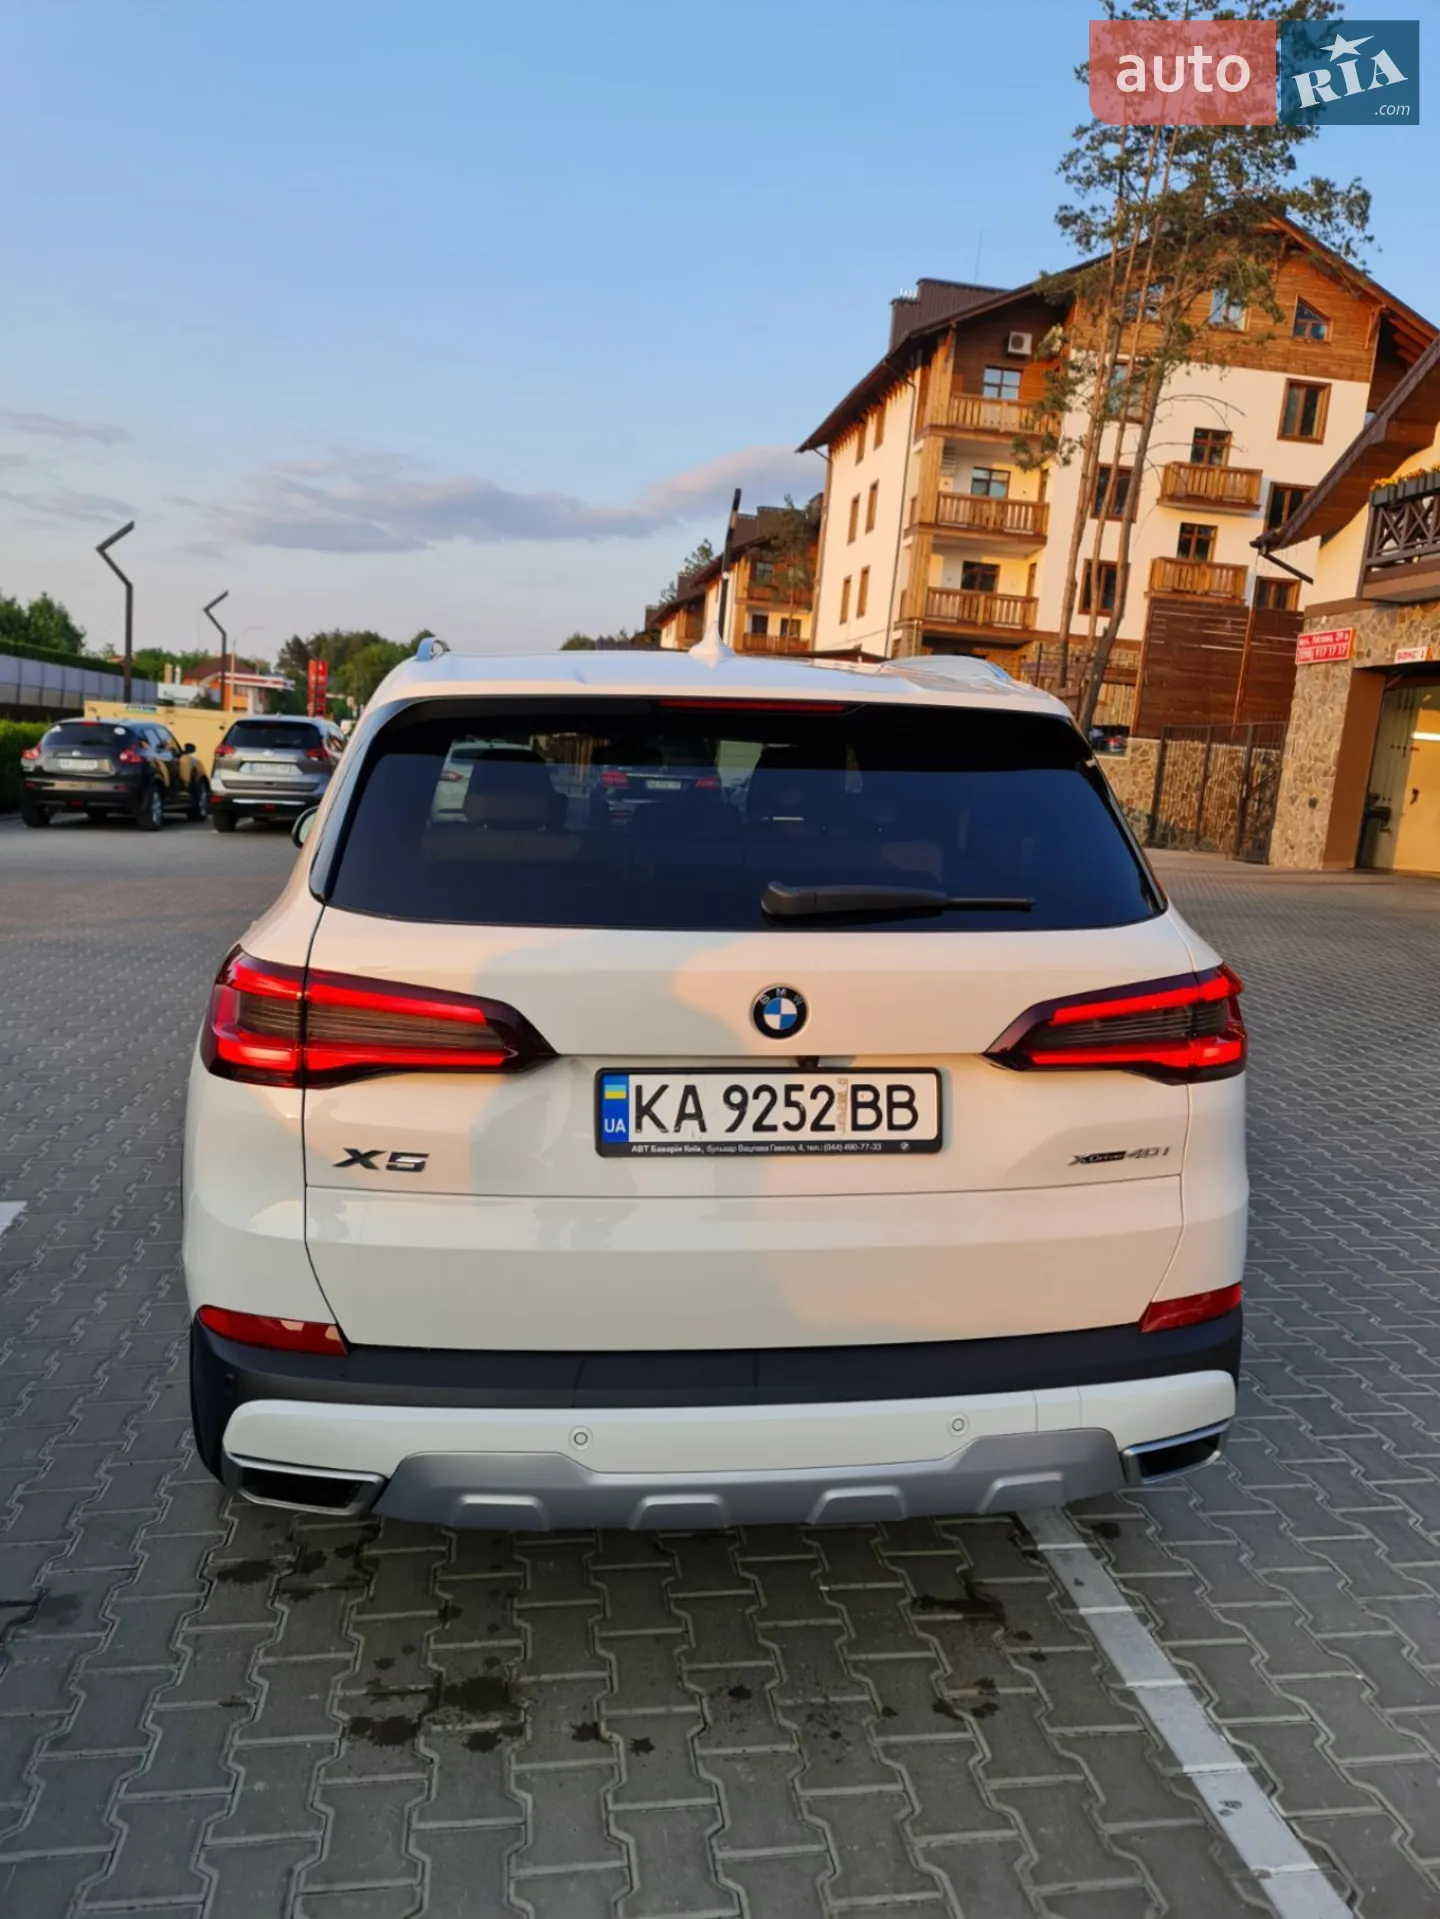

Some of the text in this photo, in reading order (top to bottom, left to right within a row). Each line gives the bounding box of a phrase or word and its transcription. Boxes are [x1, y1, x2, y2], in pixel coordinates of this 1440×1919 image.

[759, 988, 804, 1006] BMW
[634, 1084, 919, 1134] KA 9252 BB
[604, 1118, 626, 1133] UA
[332, 1147, 430, 1172] X5
